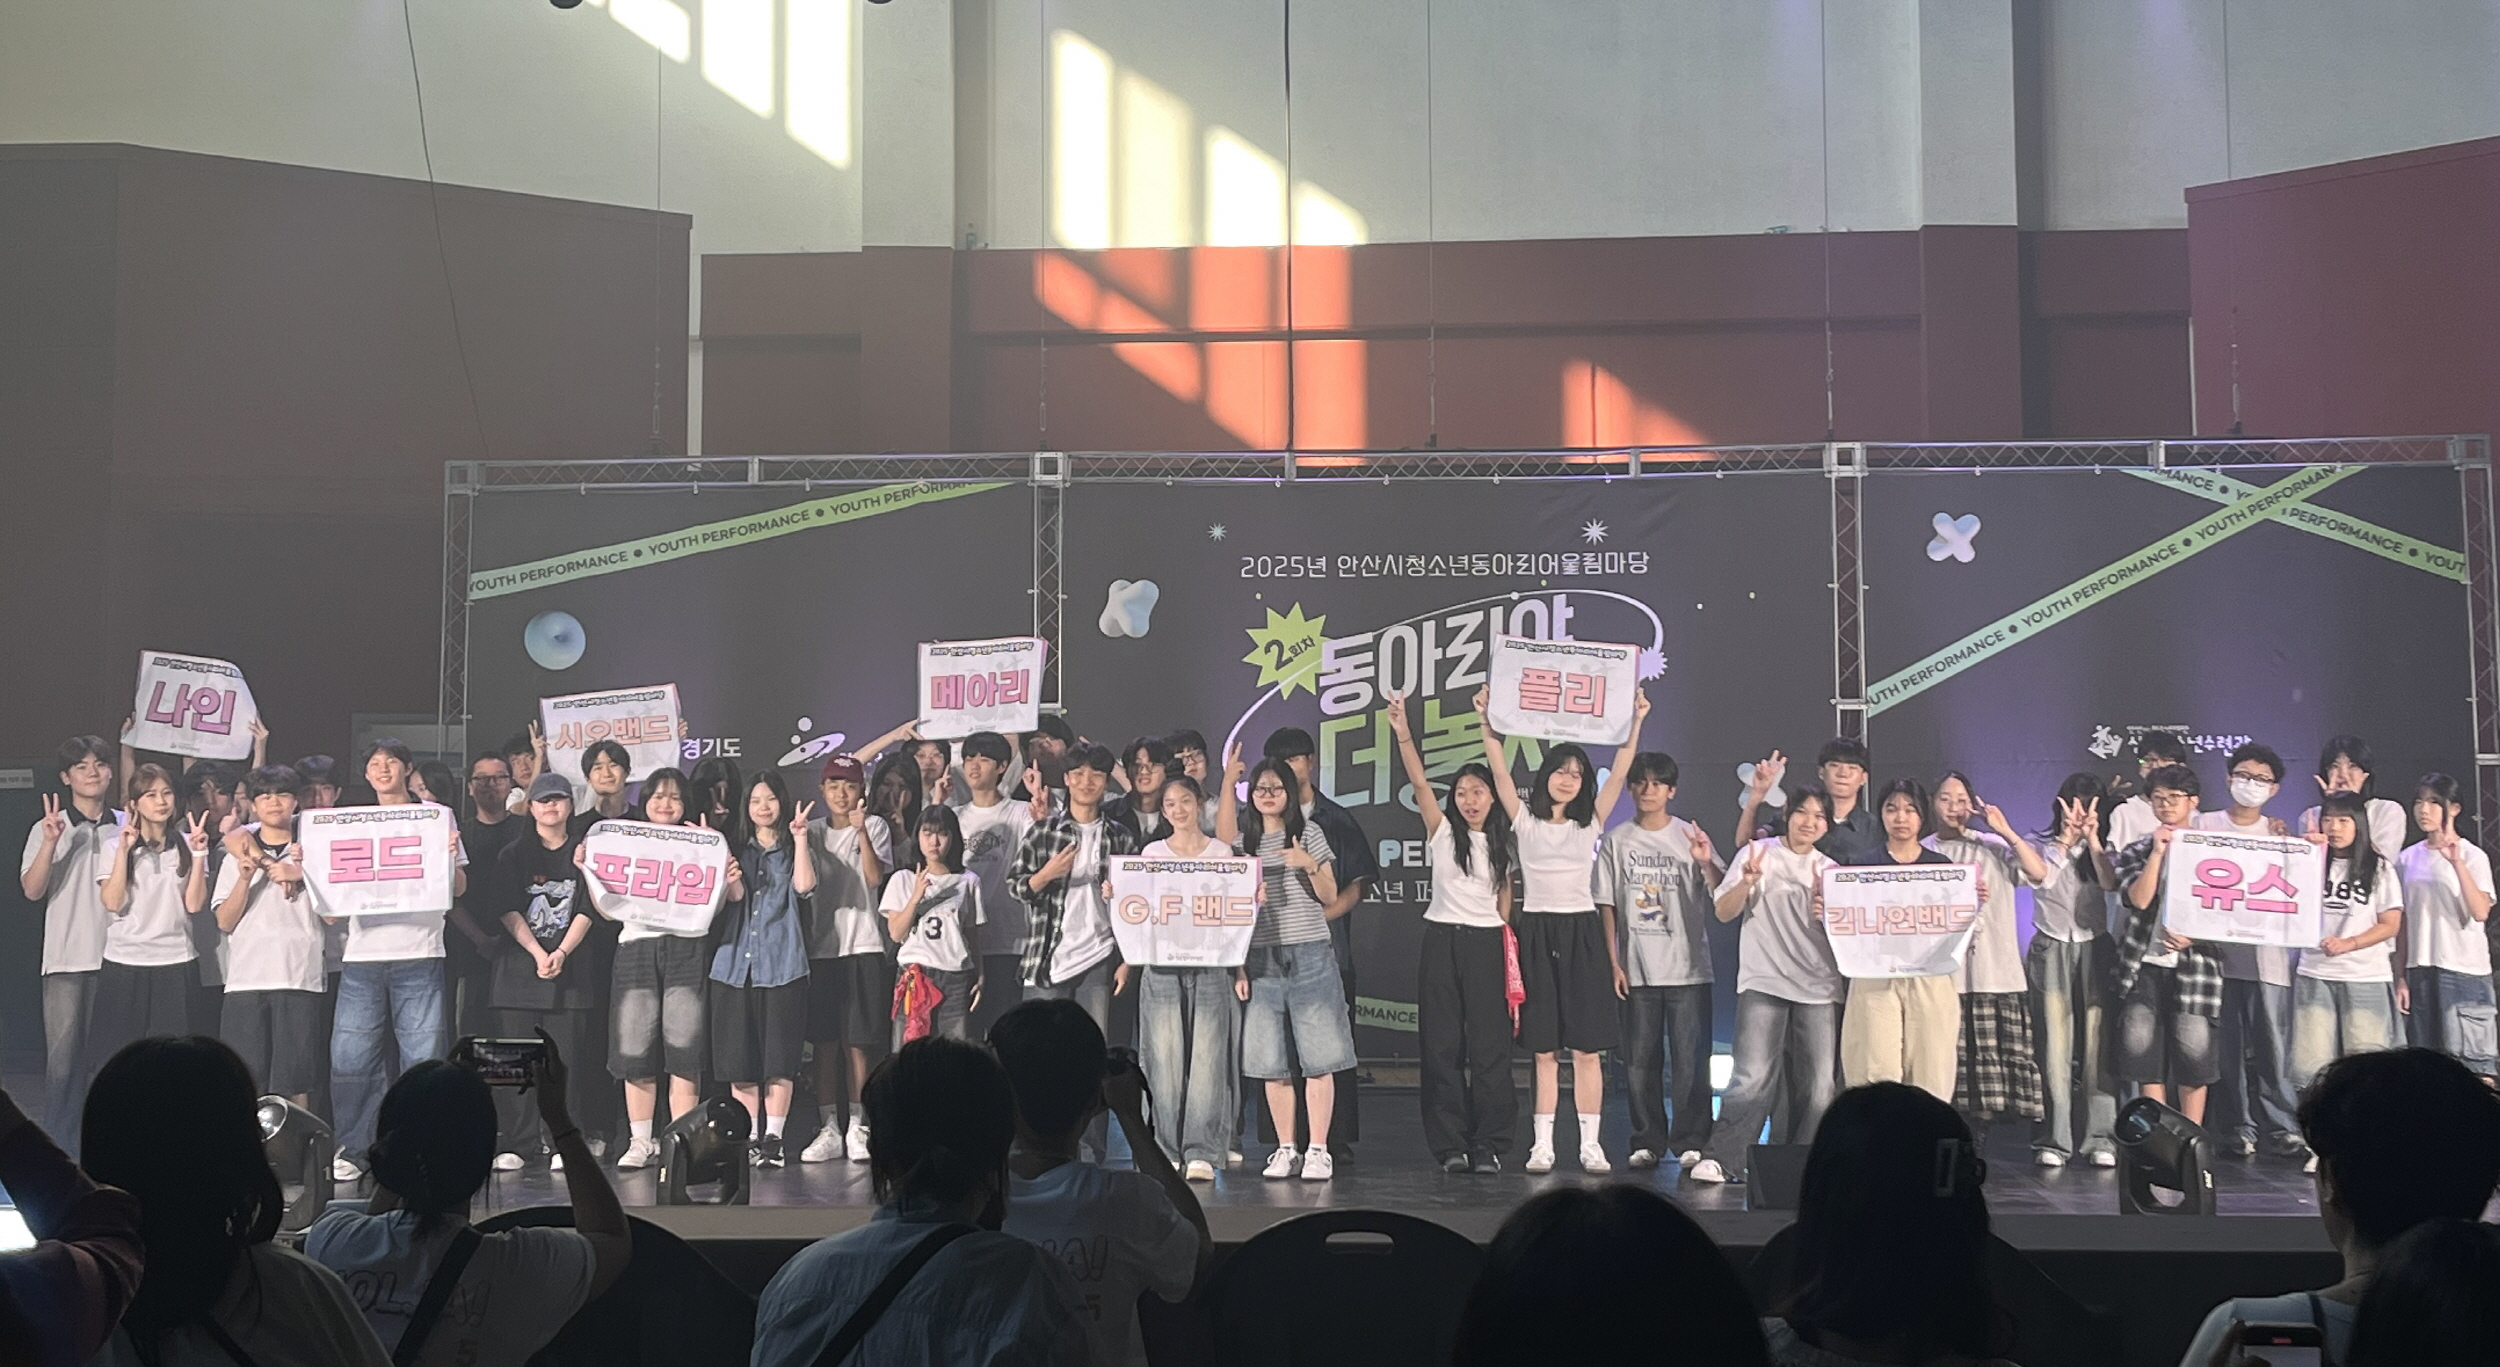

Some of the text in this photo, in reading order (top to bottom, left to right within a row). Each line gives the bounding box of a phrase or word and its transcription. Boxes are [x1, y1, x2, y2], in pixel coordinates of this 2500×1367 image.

[520, 551, 628, 583] PERFORMANCE
[648, 534, 699, 556] YOUTH
[702, 509, 810, 544] PERFORMANCE
[830, 493, 881, 516] YOUTH
[2289, 507, 2466, 573] PERFORMANCE YOUT
[1240, 551, 1650, 578] 2025년 안산시청소년동아리어울림마당
[1869, 683, 1901, 705] UTH
[1900, 629, 2006, 691] PERFORMANCE
[2021, 595, 2073, 629] YOUTH
[2072, 542, 2180, 605] PERFORMANCE
[2195, 508, 2248, 541] YOUTH
[145, 681, 237, 735] 나인
[930, 669, 1029, 710] 메아리
[1519, 667, 1606, 717] 플리
[555, 715, 672, 750] 시오밴드
[681, 737, 742, 759] 경기도
[329, 835, 424, 884] 로드
[593, 853, 717, 905] 프라임
[1628, 850, 1676, 871] Sunday
[2192, 858, 2298, 914] 유스
[925, 916, 943, 940] 3
[1119, 894, 1253, 926] G.F 밴드
[1827, 904, 1975, 936] 김나연밴드
[1356, 1005, 1418, 1024] RMANCE
